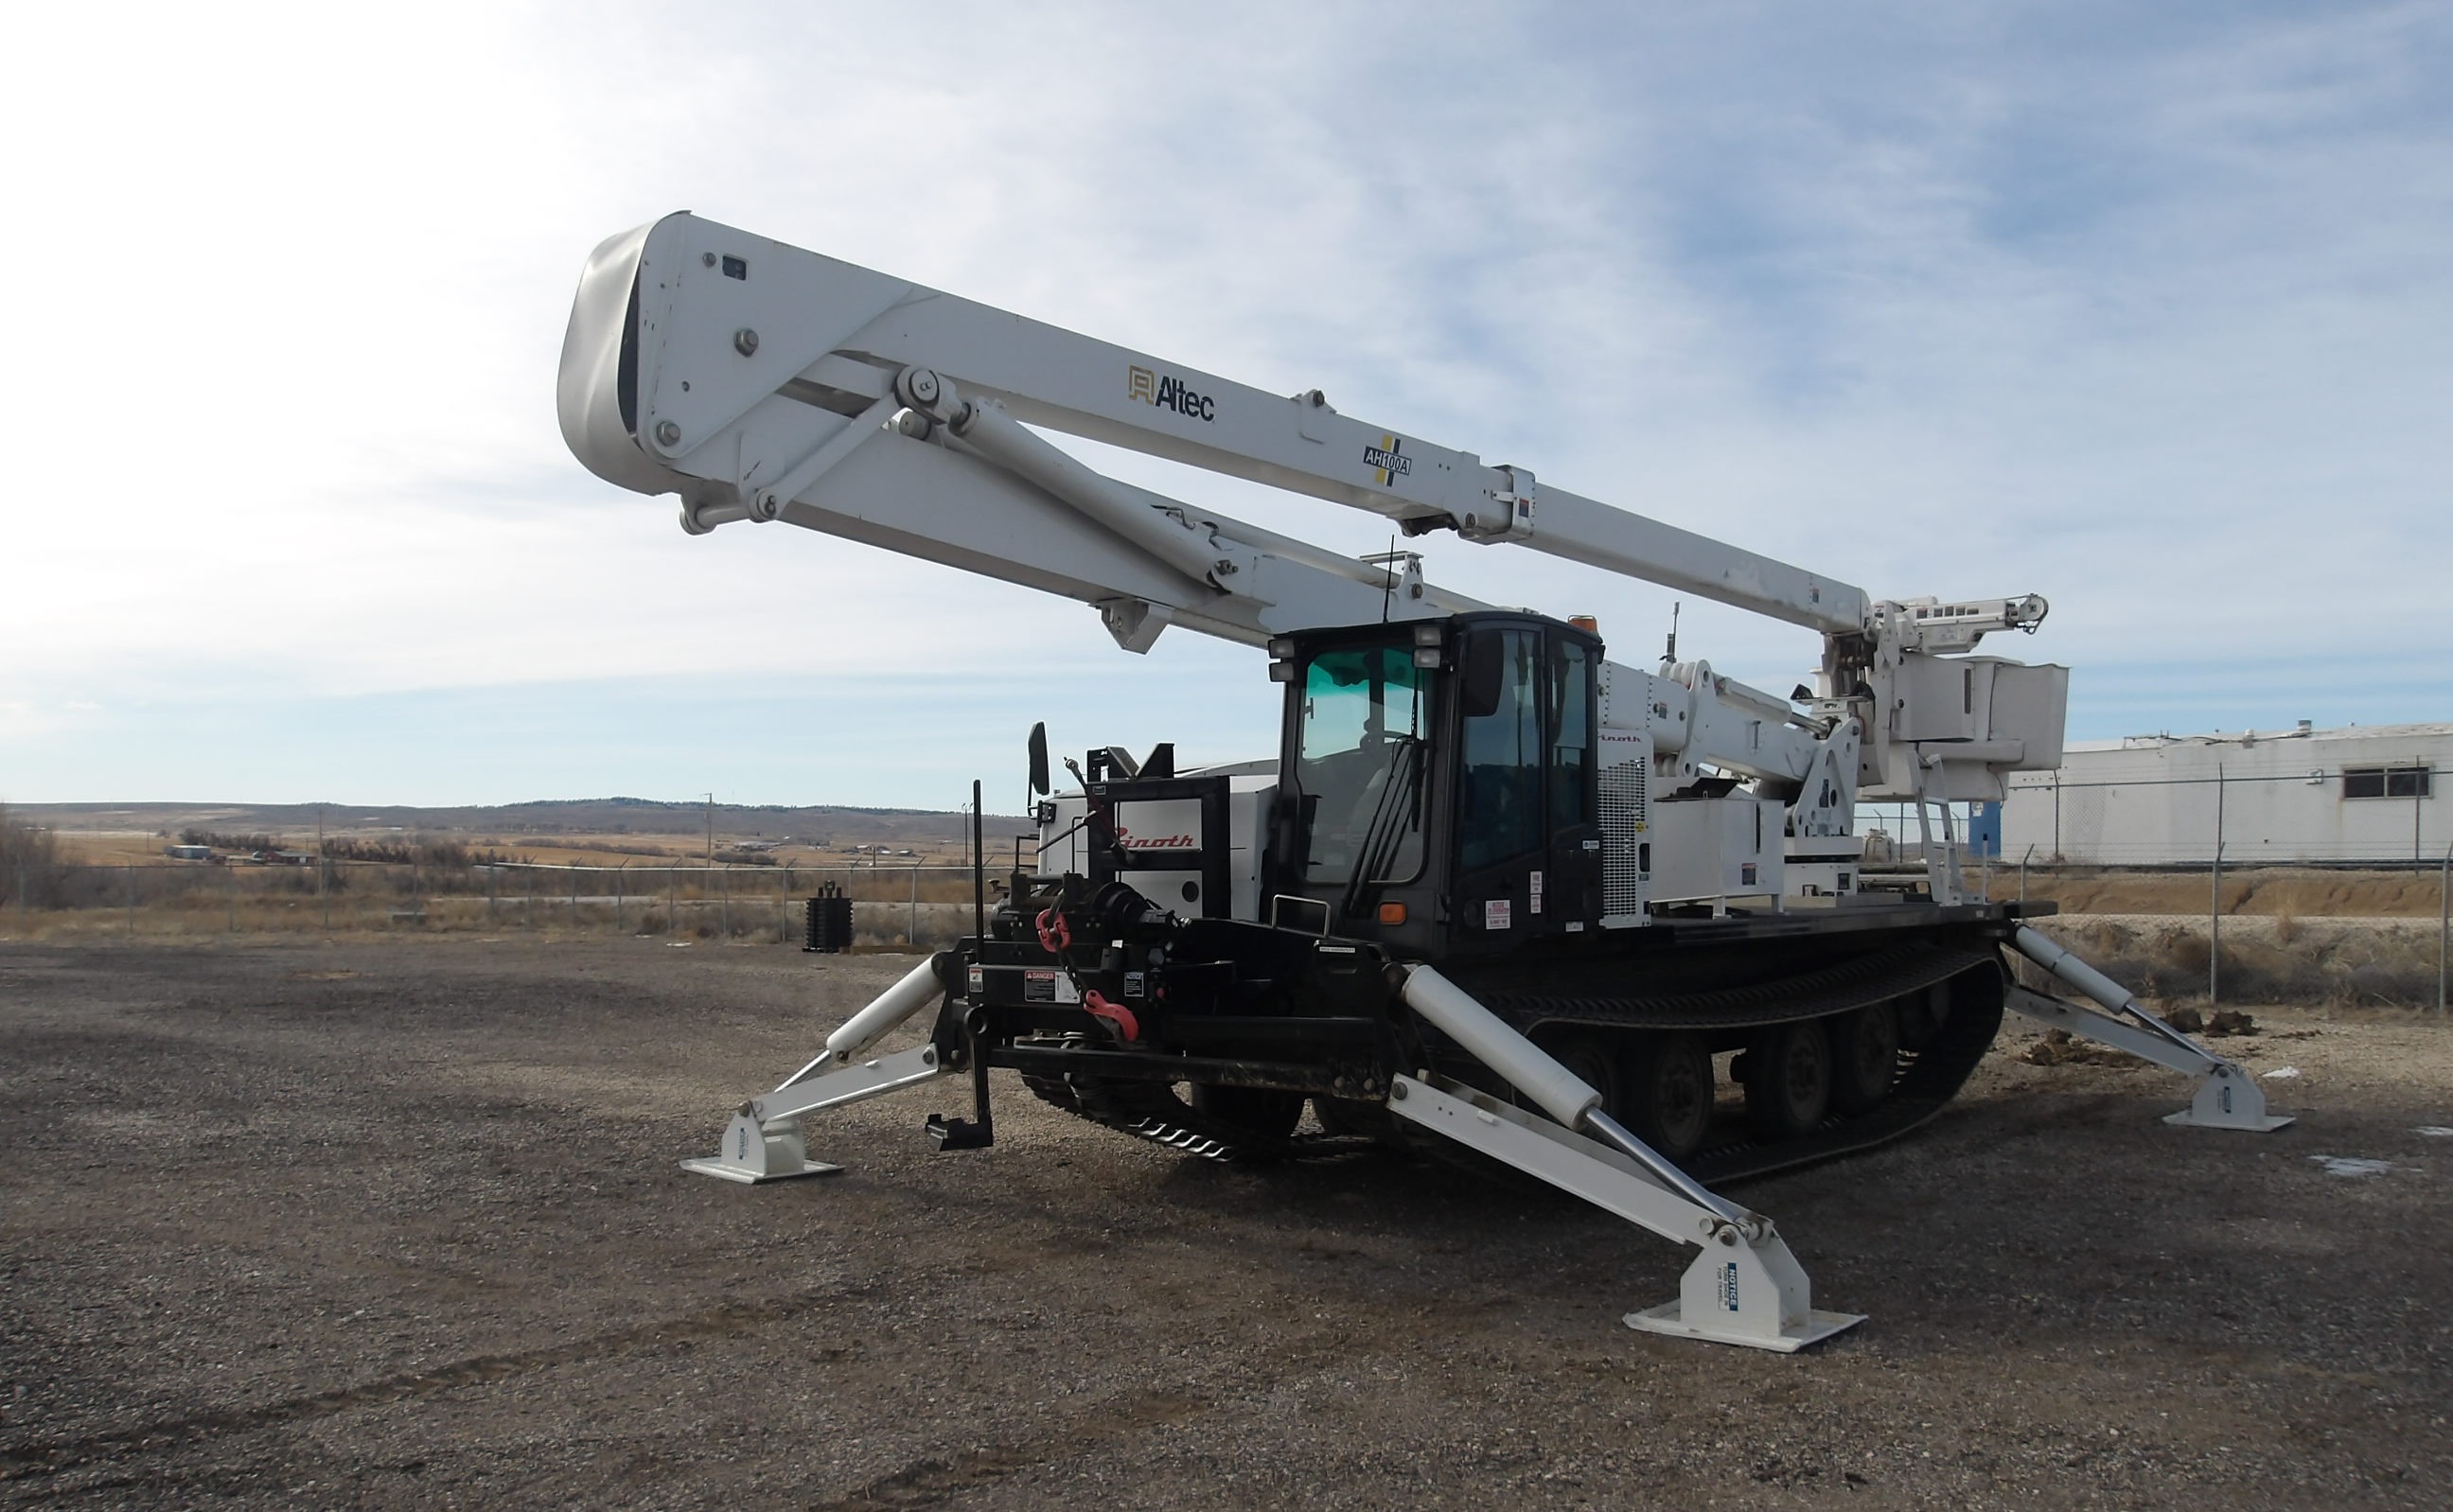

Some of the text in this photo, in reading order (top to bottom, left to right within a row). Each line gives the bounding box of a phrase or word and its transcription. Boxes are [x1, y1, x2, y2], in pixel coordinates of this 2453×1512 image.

[1156, 376, 1215, 422] Altec
[1365, 448, 1408, 474] AH100A
[1032, 972, 1054, 980] DANGER
